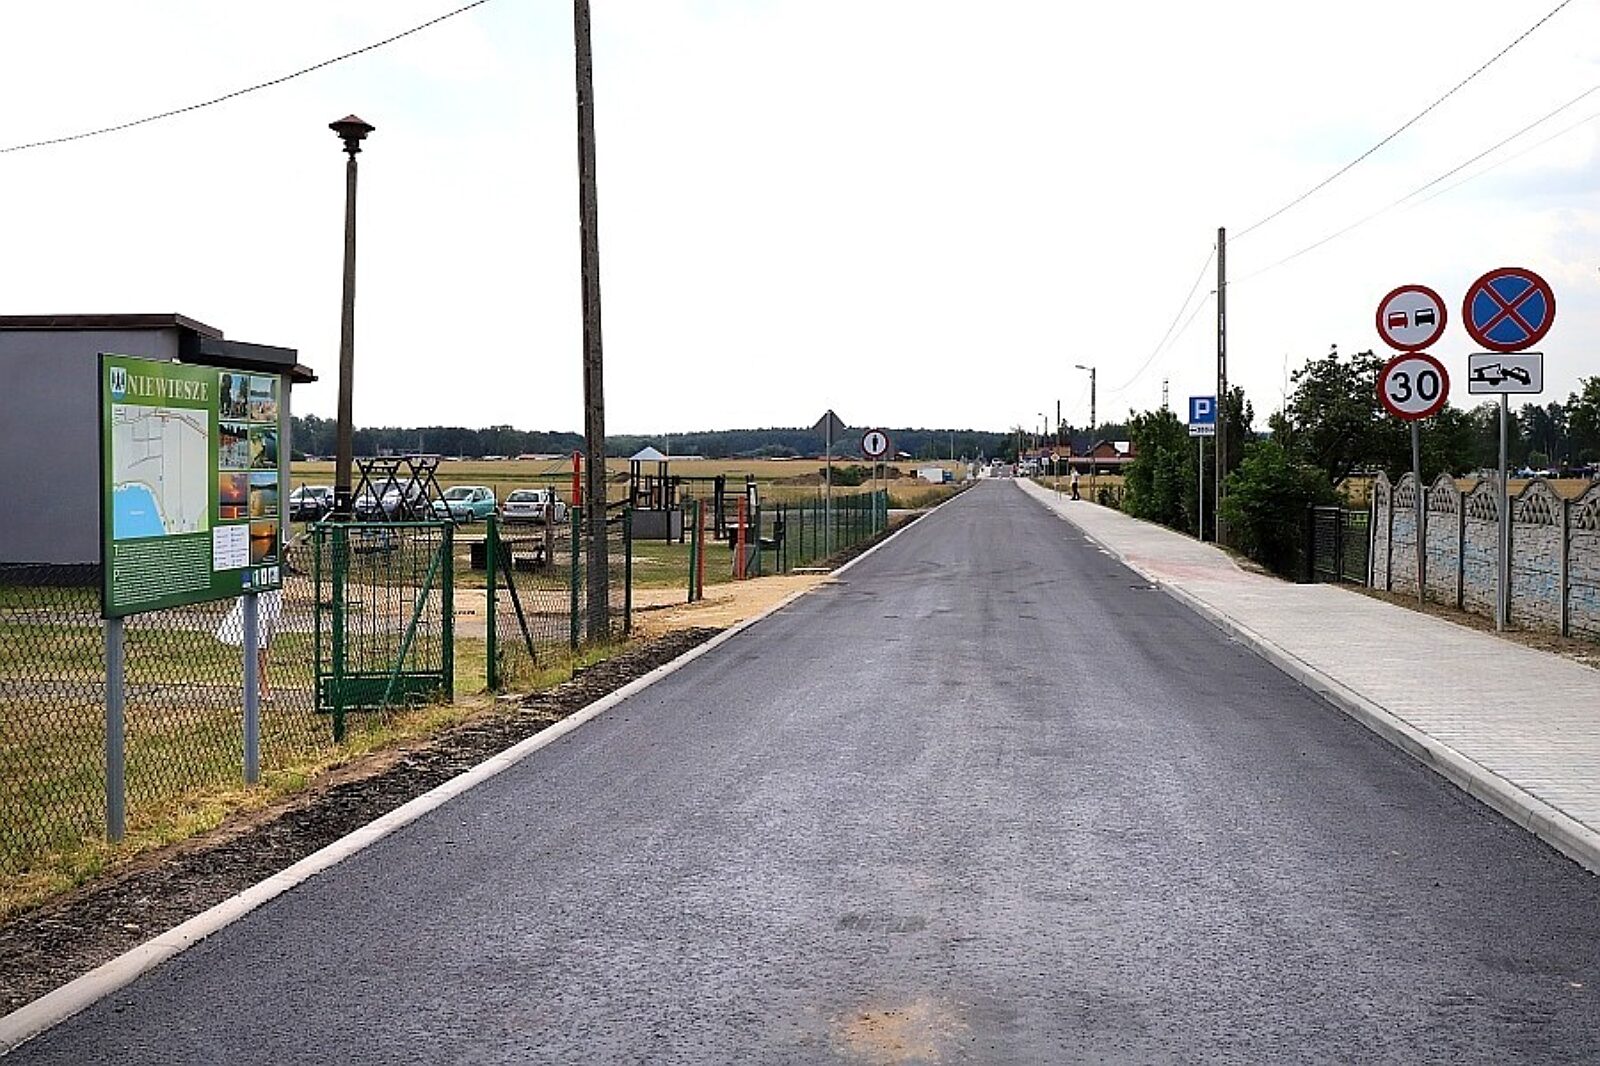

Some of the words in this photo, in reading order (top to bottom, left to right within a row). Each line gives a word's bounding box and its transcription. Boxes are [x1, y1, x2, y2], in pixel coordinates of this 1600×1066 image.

[127, 374, 209, 401] NIEWIESZE
[1390, 370, 1439, 403] 30
[1195, 399, 1210, 419] P
